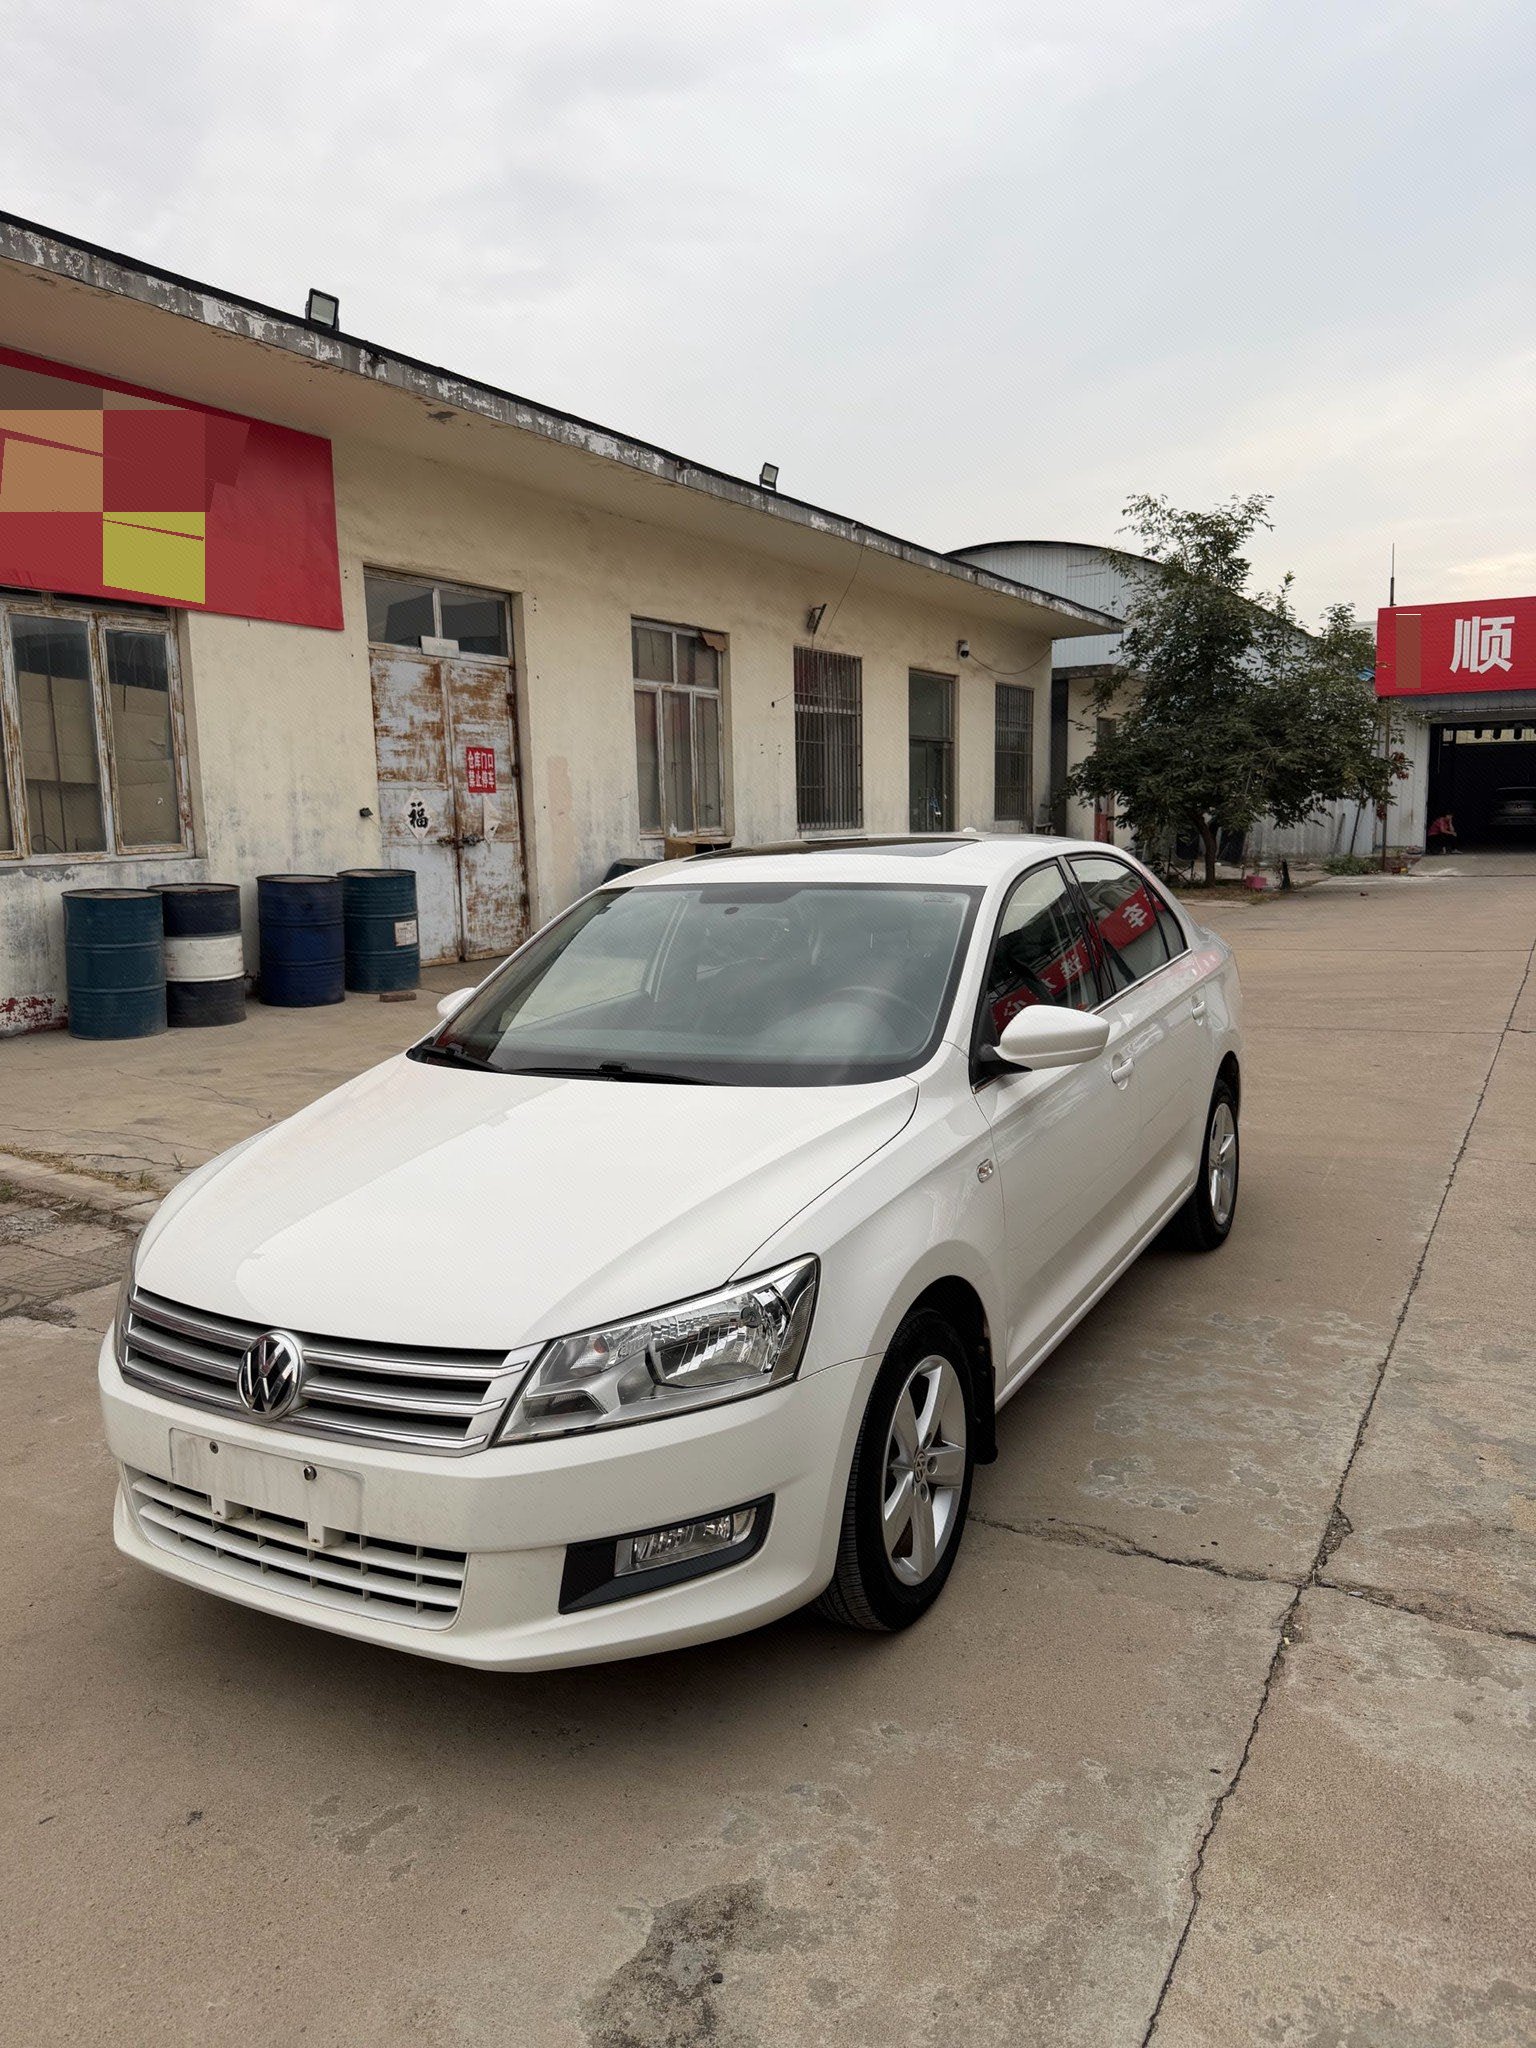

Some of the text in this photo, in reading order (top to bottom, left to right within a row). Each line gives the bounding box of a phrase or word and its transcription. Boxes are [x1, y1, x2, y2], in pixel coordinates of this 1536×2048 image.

[1449, 615, 1516, 675] 顺
[467, 750, 494, 769] 仓库门口
[468, 770, 495, 788] 禁止停车
[408, 801, 429, 829] 福
[238, 1330, 302, 1420] VW
